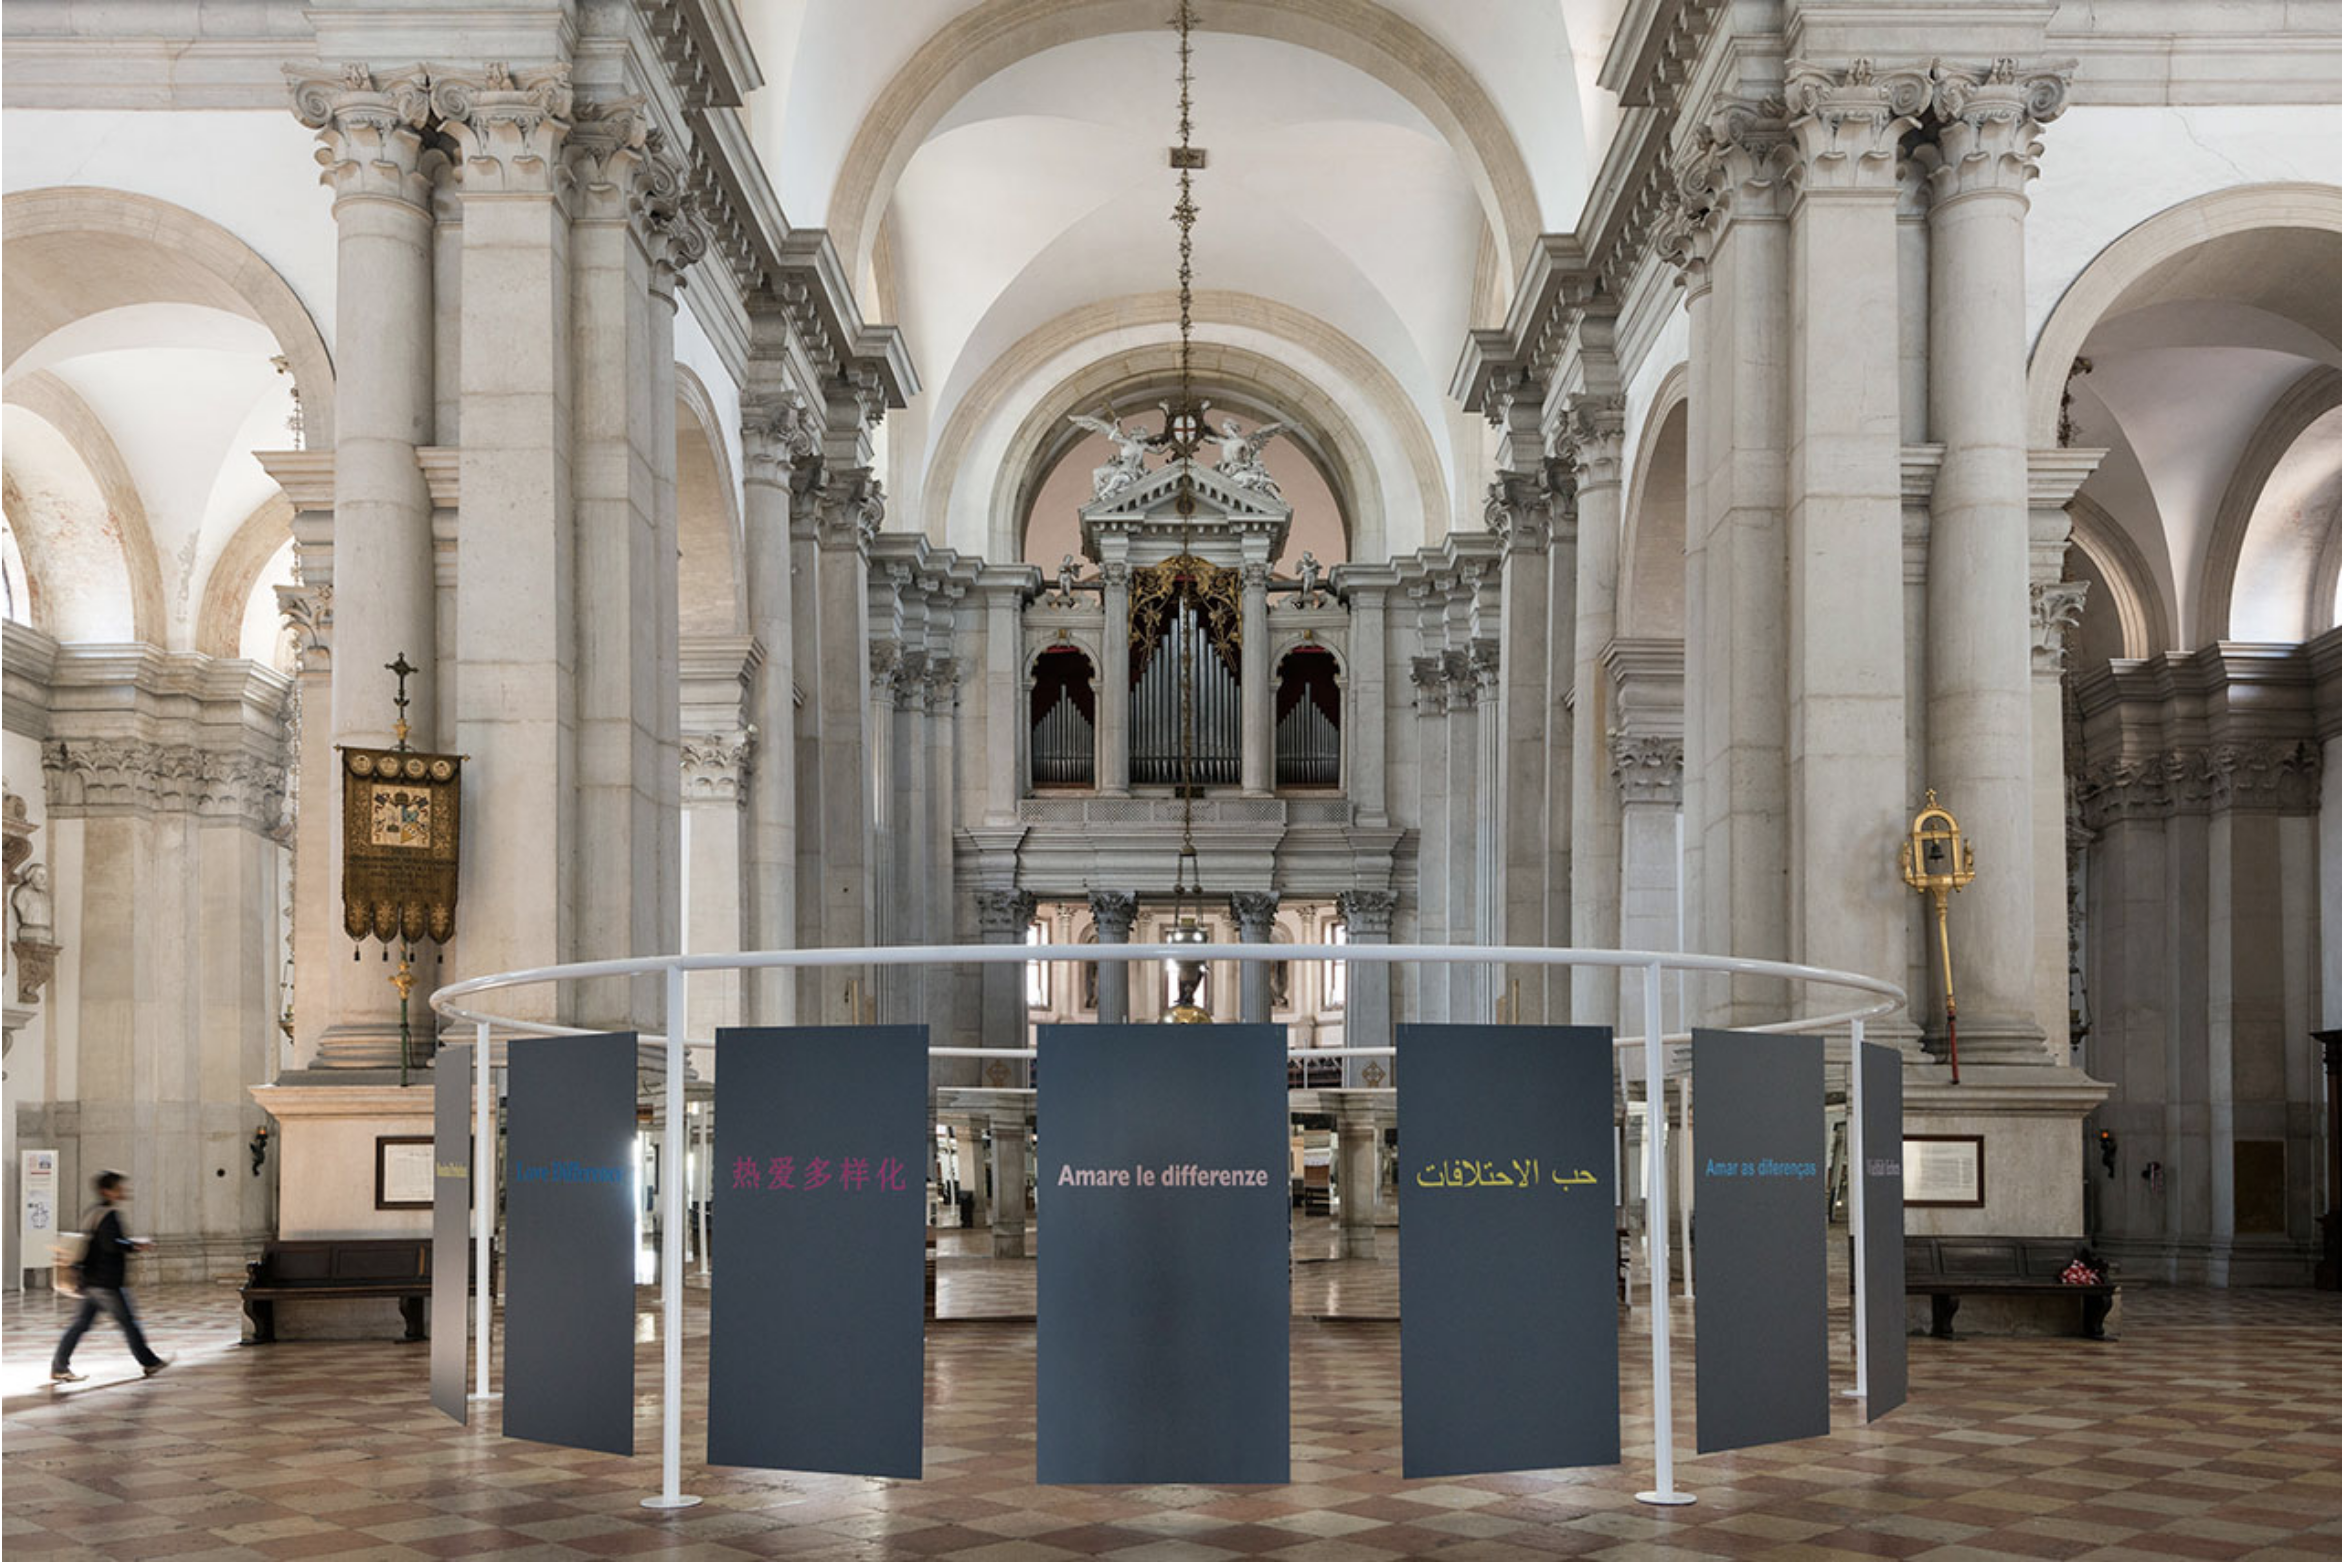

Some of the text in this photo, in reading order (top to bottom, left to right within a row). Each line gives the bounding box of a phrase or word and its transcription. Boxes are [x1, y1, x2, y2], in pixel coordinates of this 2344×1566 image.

[732, 1155, 907, 1193] 热爱多样化
[1057, 1164, 1268, 1187] Amare le differenze
[1551, 1168, 1597, 1192] حب
[1705, 1158, 1817, 1181] Amar as diferenças
